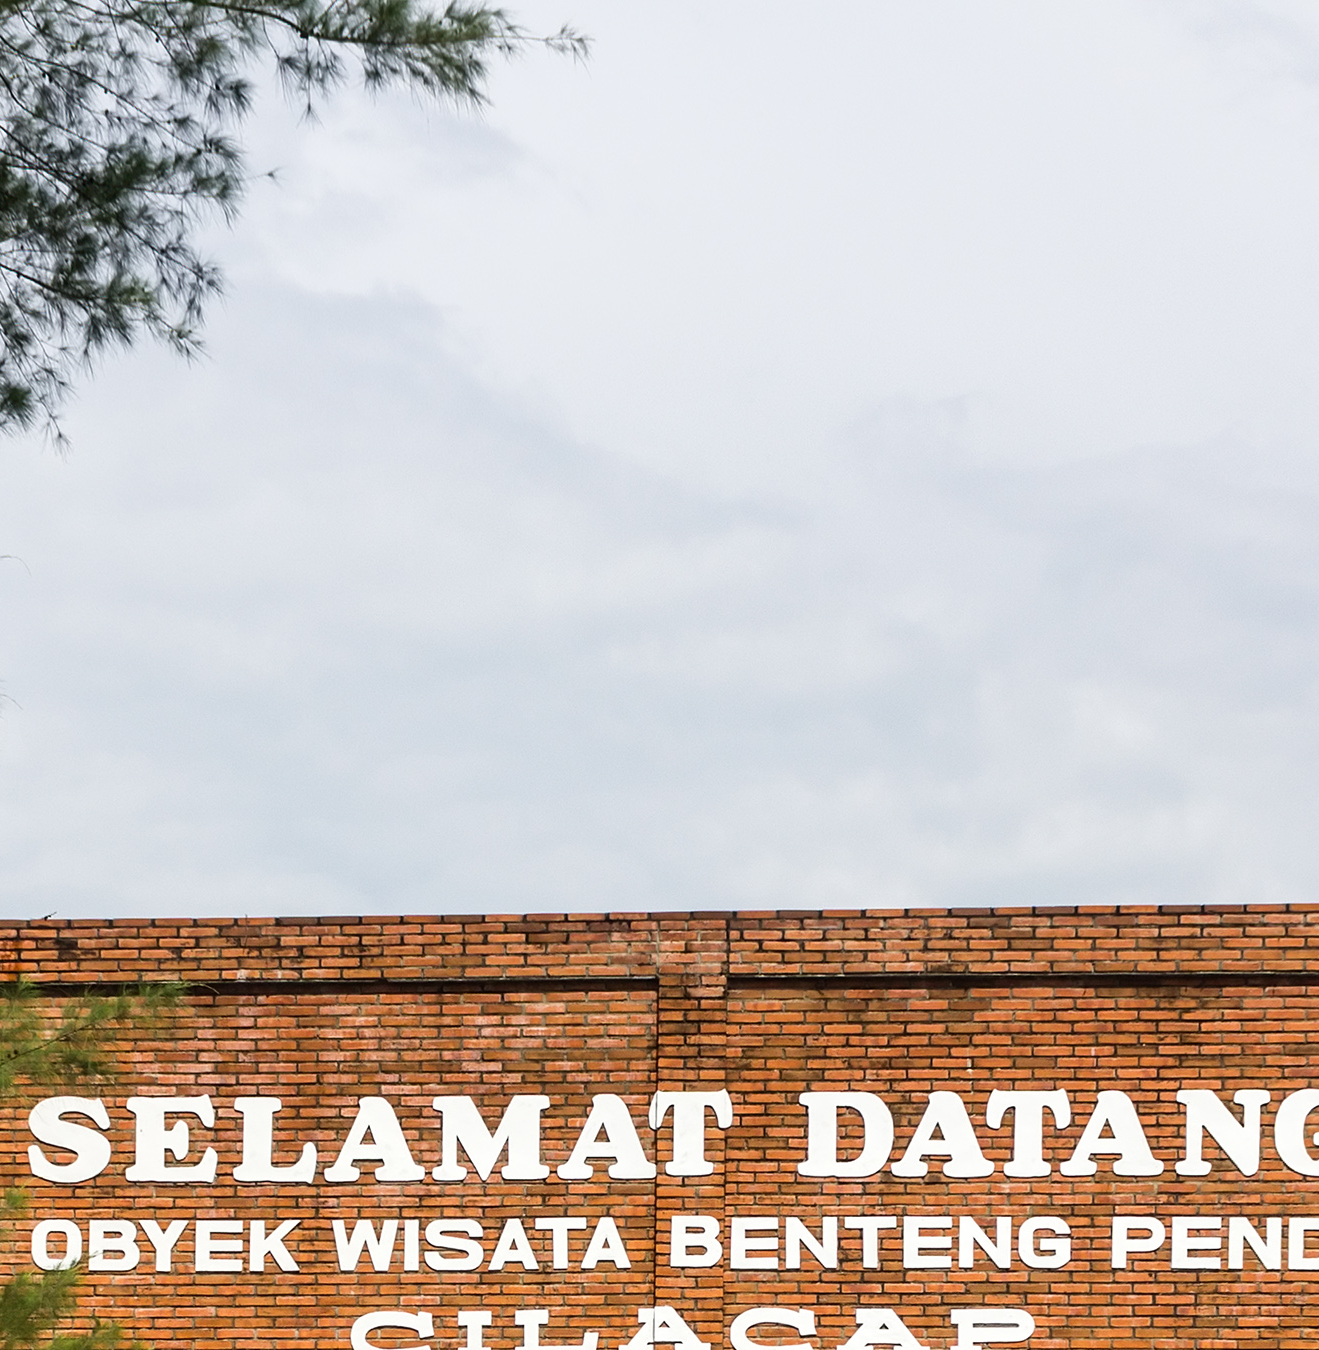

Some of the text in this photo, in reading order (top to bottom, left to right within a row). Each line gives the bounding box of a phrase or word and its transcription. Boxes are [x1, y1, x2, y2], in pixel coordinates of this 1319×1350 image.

[26, 1088, 735, 1185] SELAMAT
[30, 1218, 302, 1273] OBYEK
[330, 1216, 633, 1273] WISATA
[669, 1214, 1073, 1271] BENTENG
